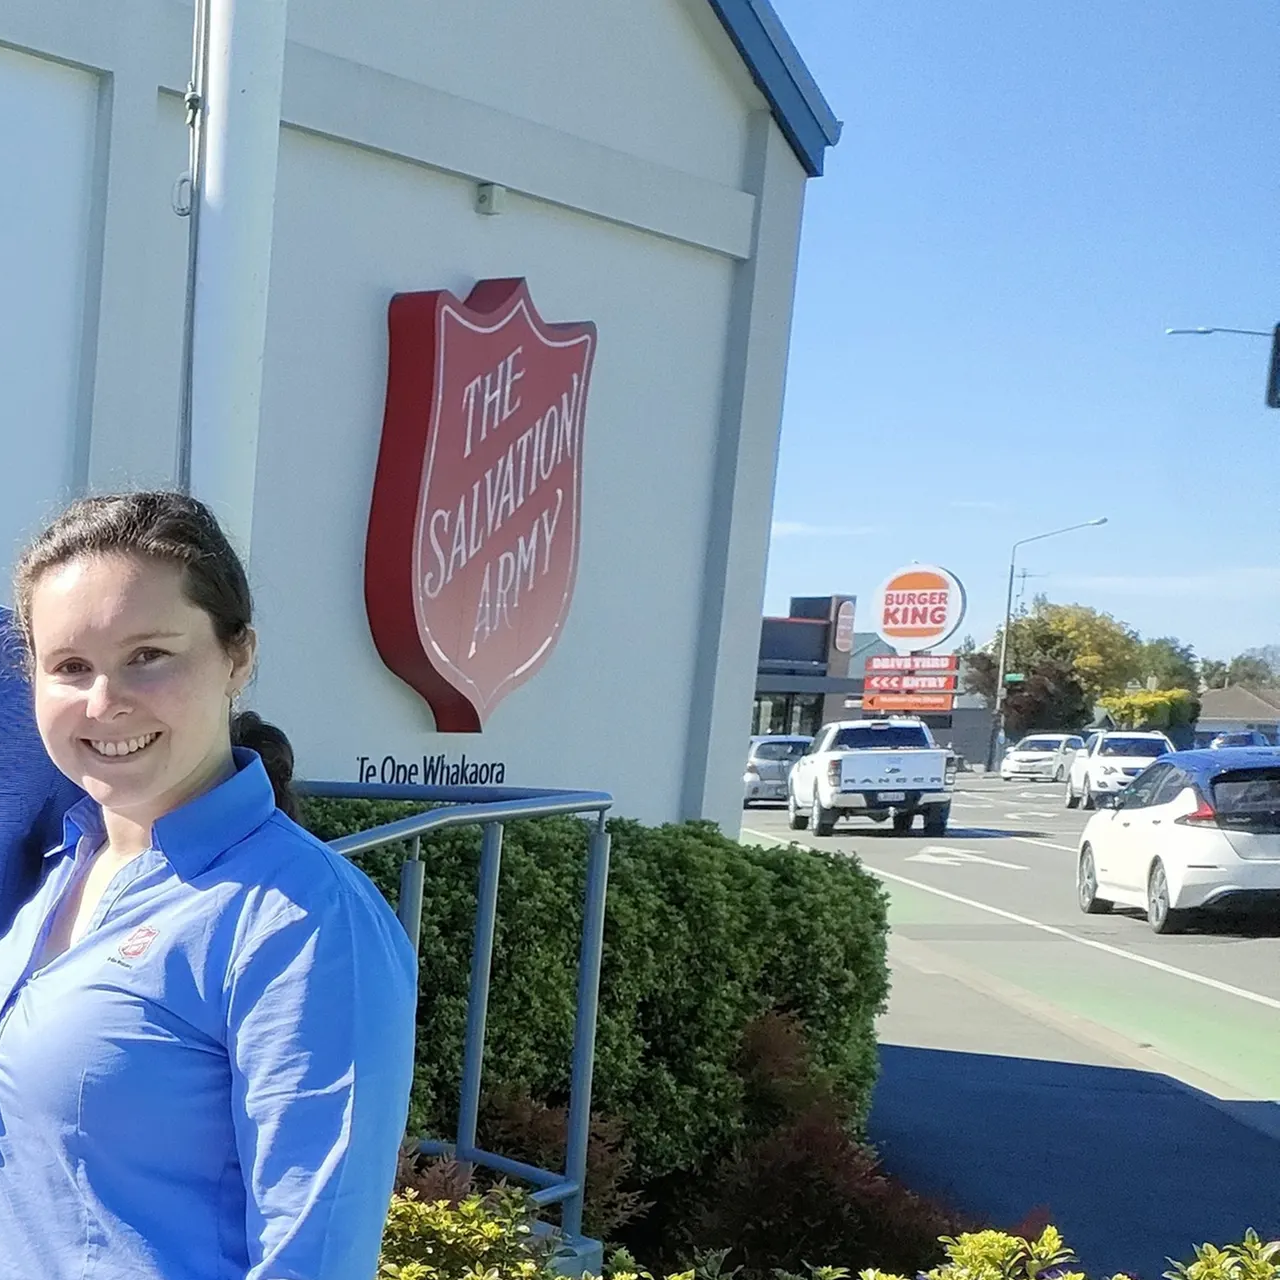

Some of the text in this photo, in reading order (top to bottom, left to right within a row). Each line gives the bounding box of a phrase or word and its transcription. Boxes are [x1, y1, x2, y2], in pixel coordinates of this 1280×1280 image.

[462, 346, 526, 458] THE
[423, 372, 578, 598] SALVATION
[468, 487, 562, 659] ARMY
[885, 592, 949, 606] BURGER
[883, 606, 947, 625] KING
[357, 756, 377, 784] Te
[423, 753, 506, 787] Whakaora
